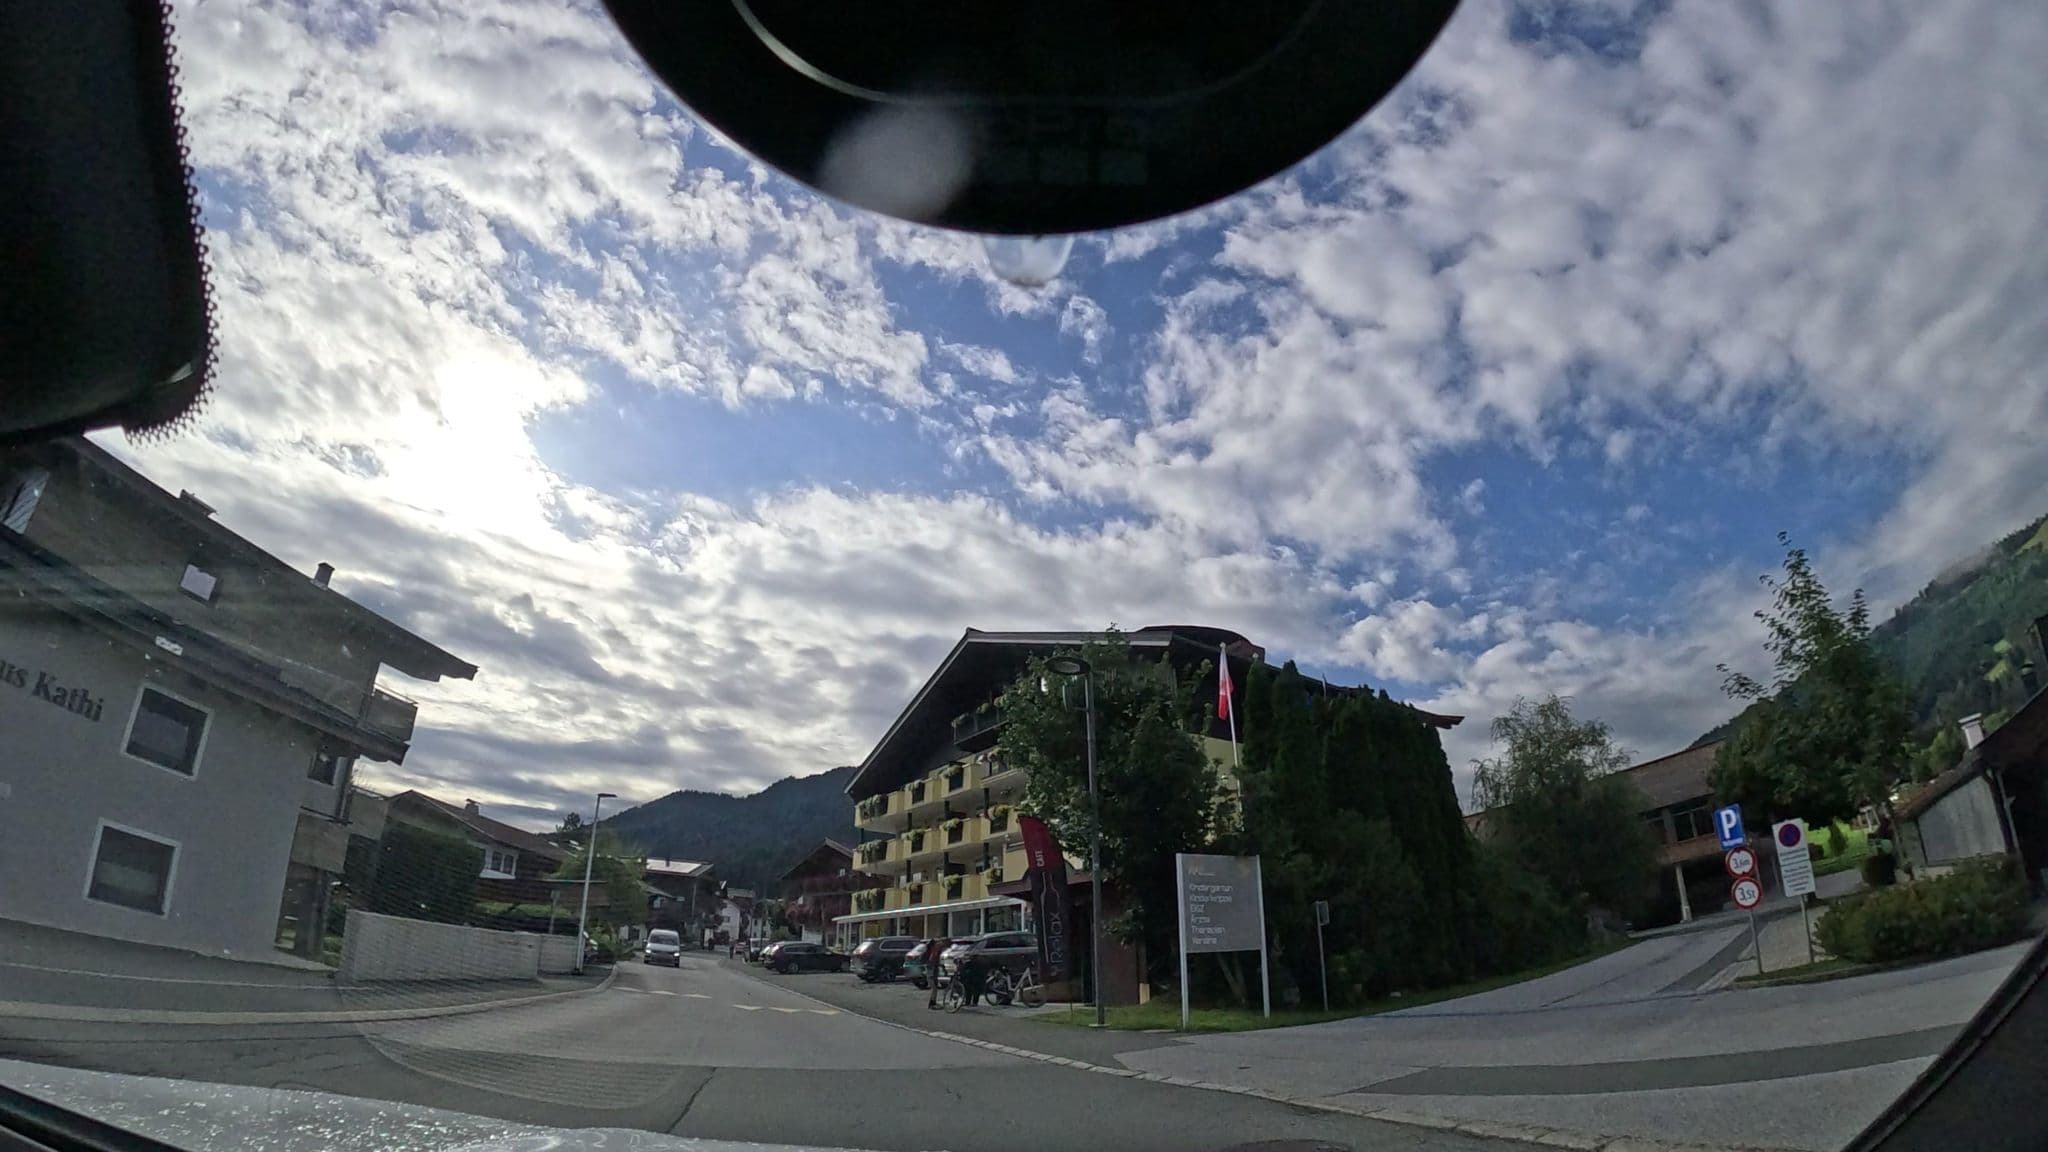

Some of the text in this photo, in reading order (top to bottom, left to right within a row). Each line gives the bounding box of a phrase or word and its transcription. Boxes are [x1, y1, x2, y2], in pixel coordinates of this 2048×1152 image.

[31, 671, 104, 722] Kathi
[1720, 809, 1737, 839] P
[1189, 884, 1233, 893] Kindergarten
